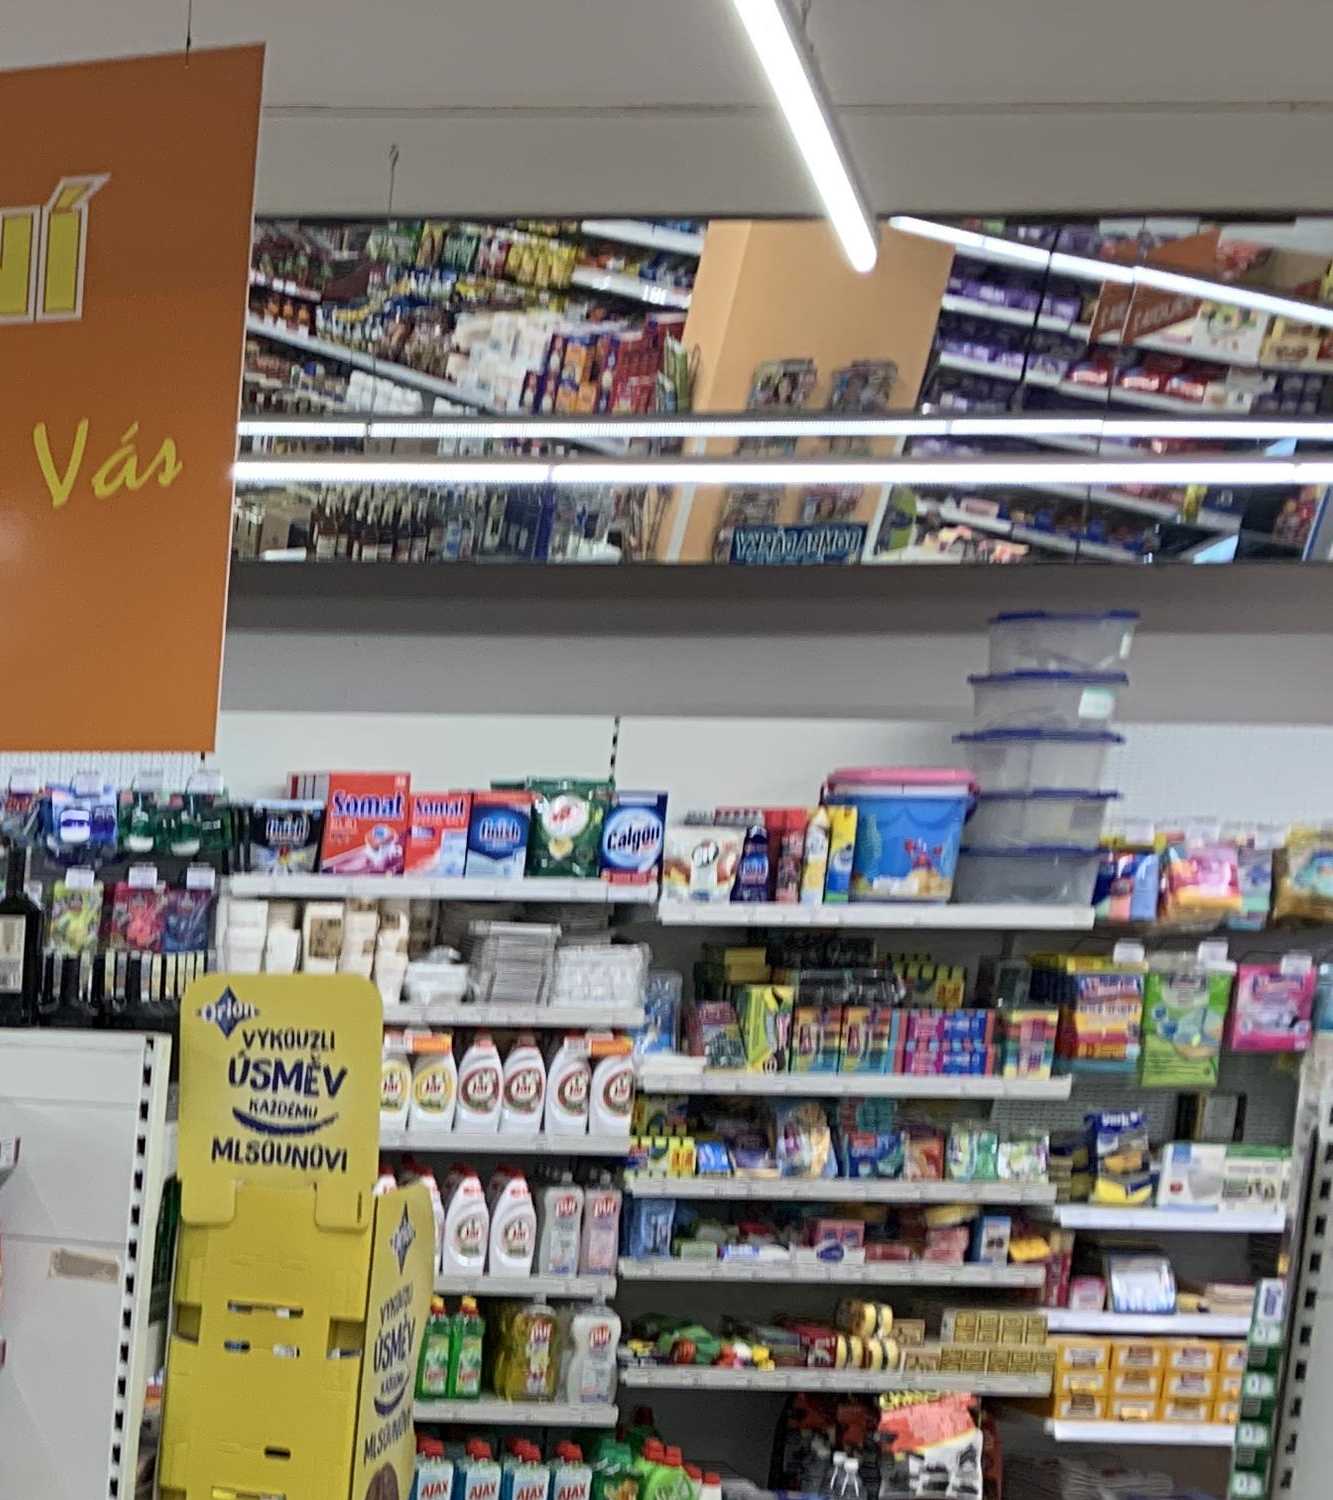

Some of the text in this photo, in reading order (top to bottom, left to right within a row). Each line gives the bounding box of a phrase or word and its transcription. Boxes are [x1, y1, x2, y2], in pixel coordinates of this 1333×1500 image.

[32, 419, 183, 508] Vás
[332, 789, 405, 821] Somat
[242, 1028, 336, 1050] VYKOUZLI
[228, 1051, 348, 1099] ÚSMĚV
[249, 1097, 318, 1120] KAŽDÉMU
[211, 1137, 348, 1175] MLSOUNOVI
[421, 1478, 449, 1498] AJAX
[469, 1482, 497, 1500] AJAX
[558, 1483, 586, 1500] AJAX
